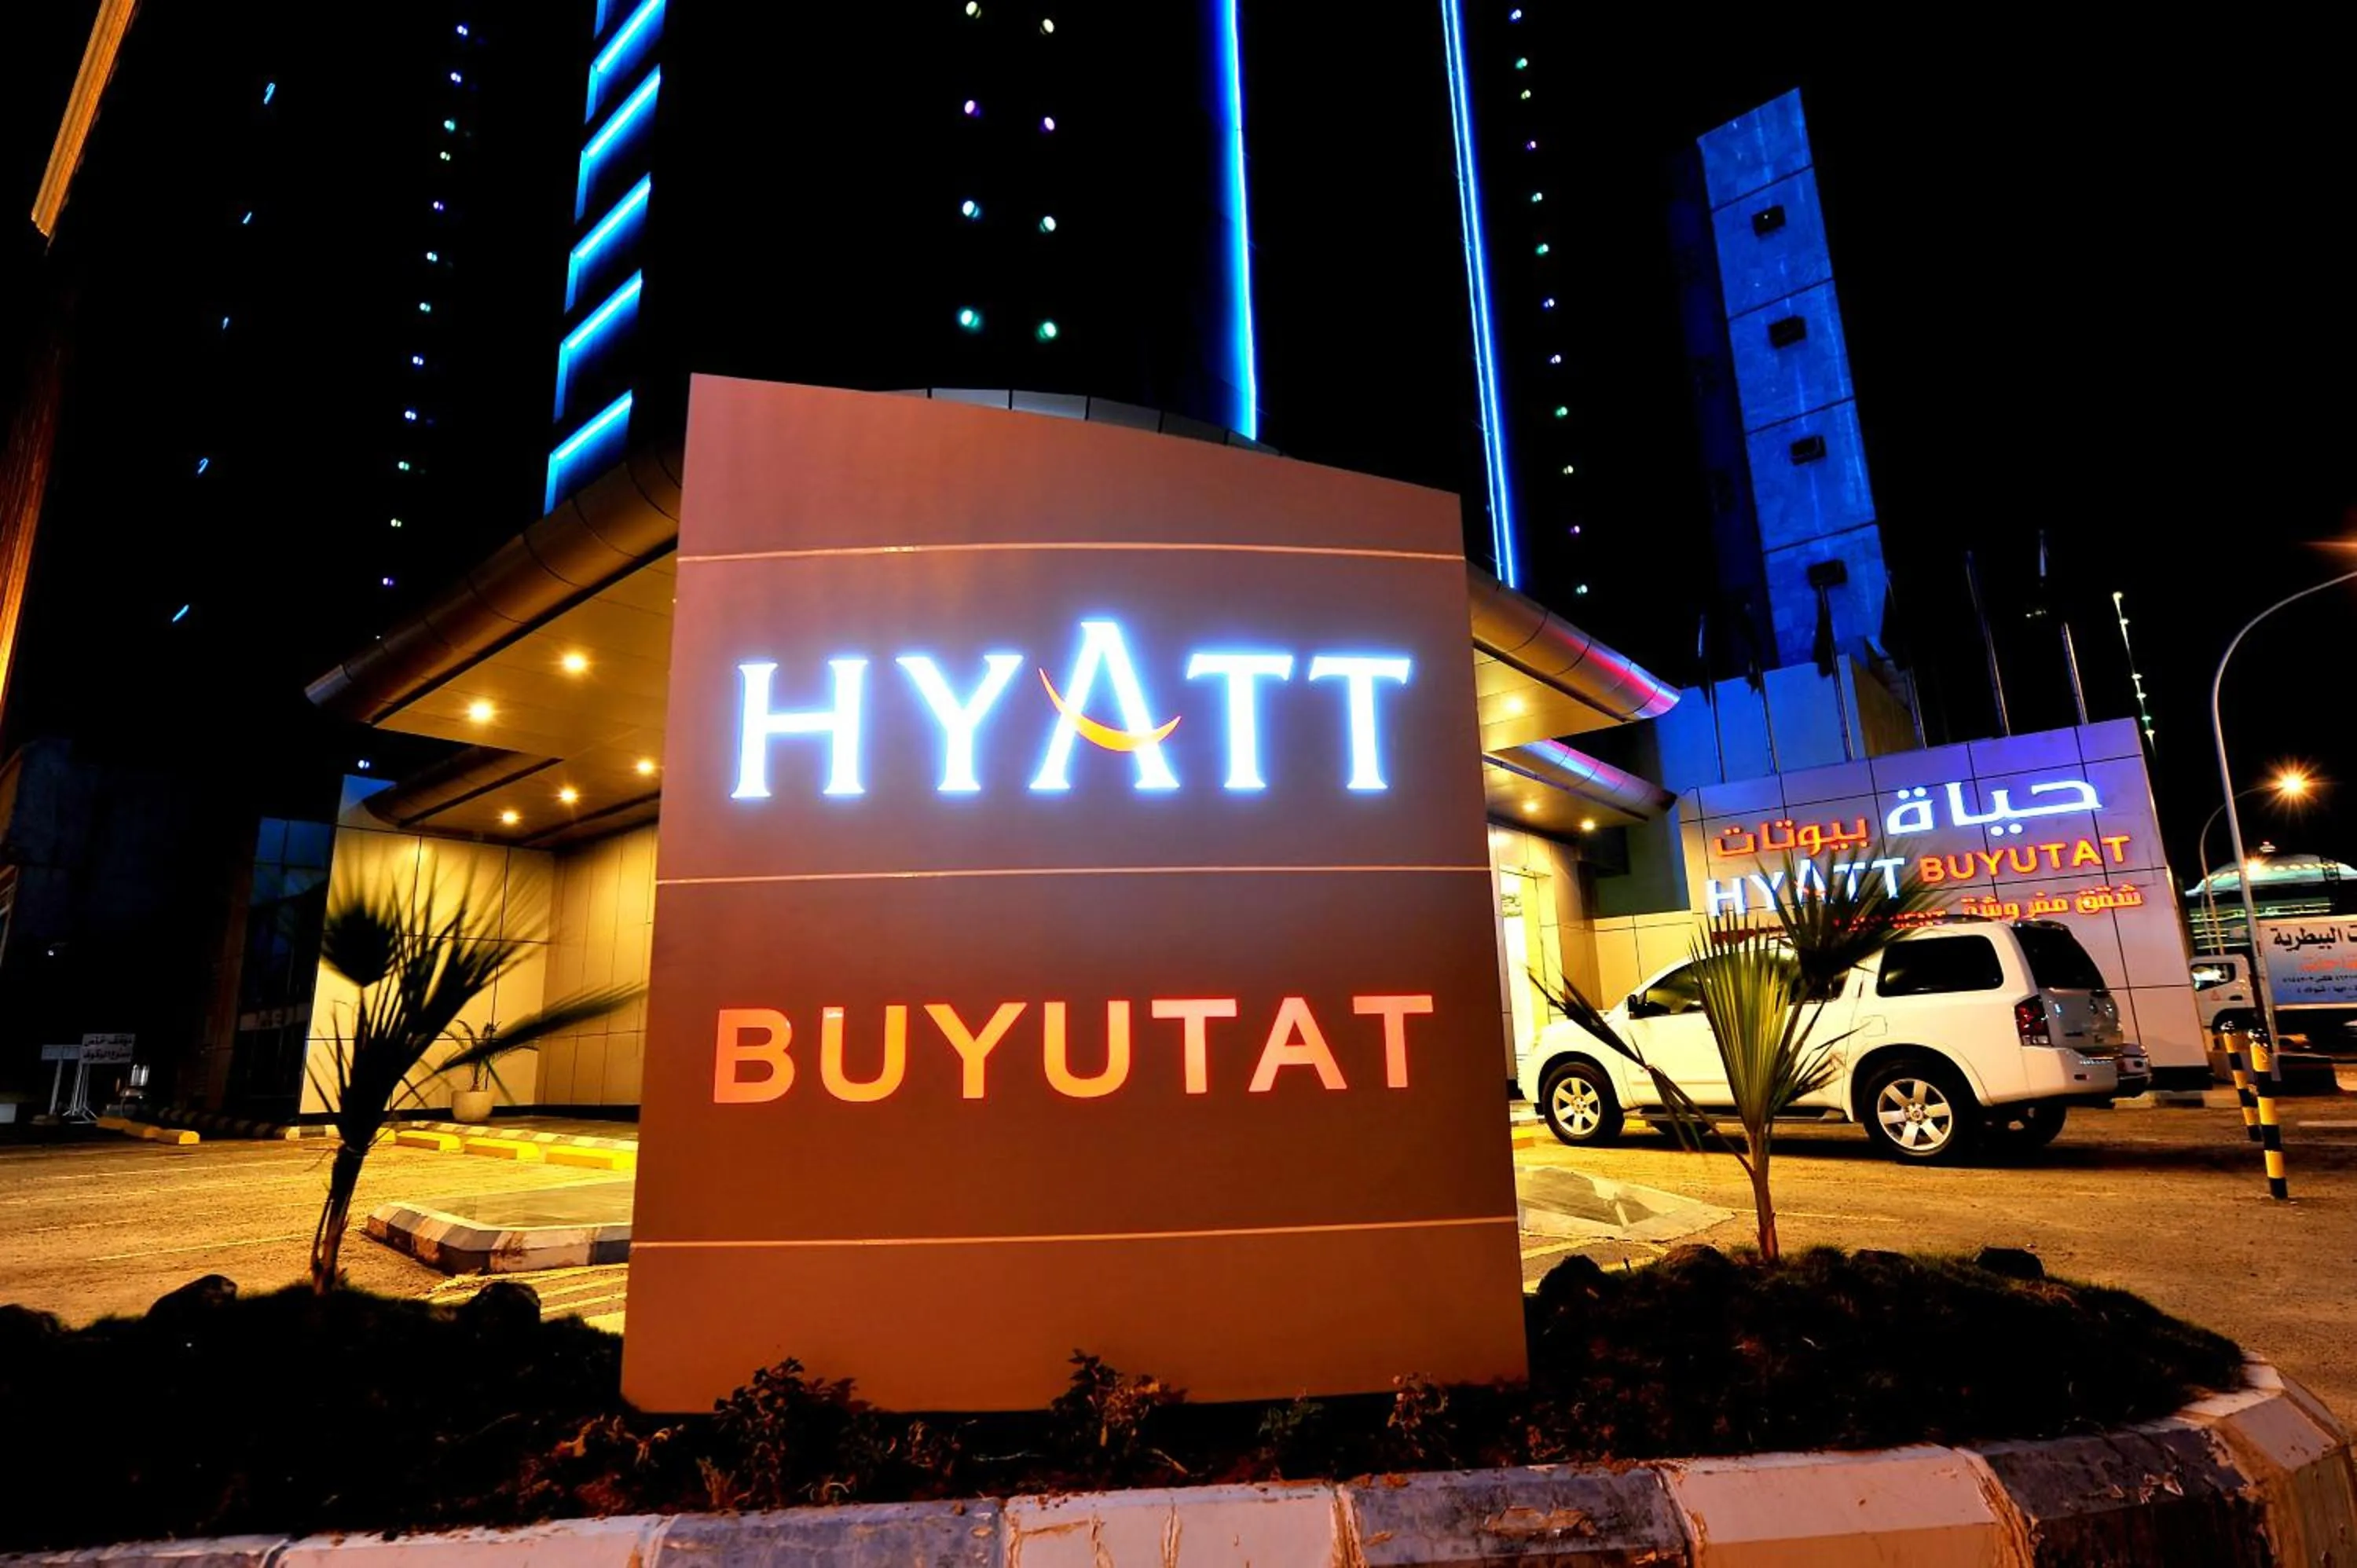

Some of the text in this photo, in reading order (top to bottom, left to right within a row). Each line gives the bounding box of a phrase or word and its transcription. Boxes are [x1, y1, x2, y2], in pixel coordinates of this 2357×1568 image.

[731, 620, 1412, 799] HYATT
[1714, 779, 2103, 856] حياة بيوتات
[1705, 836, 2131, 918] HYATT BUYUTAT
[2075, 882, 2143, 914] شقق
[2270, 925, 2343, 951] البيطرية
[713, 994, 1434, 1104] BUYUTAT
